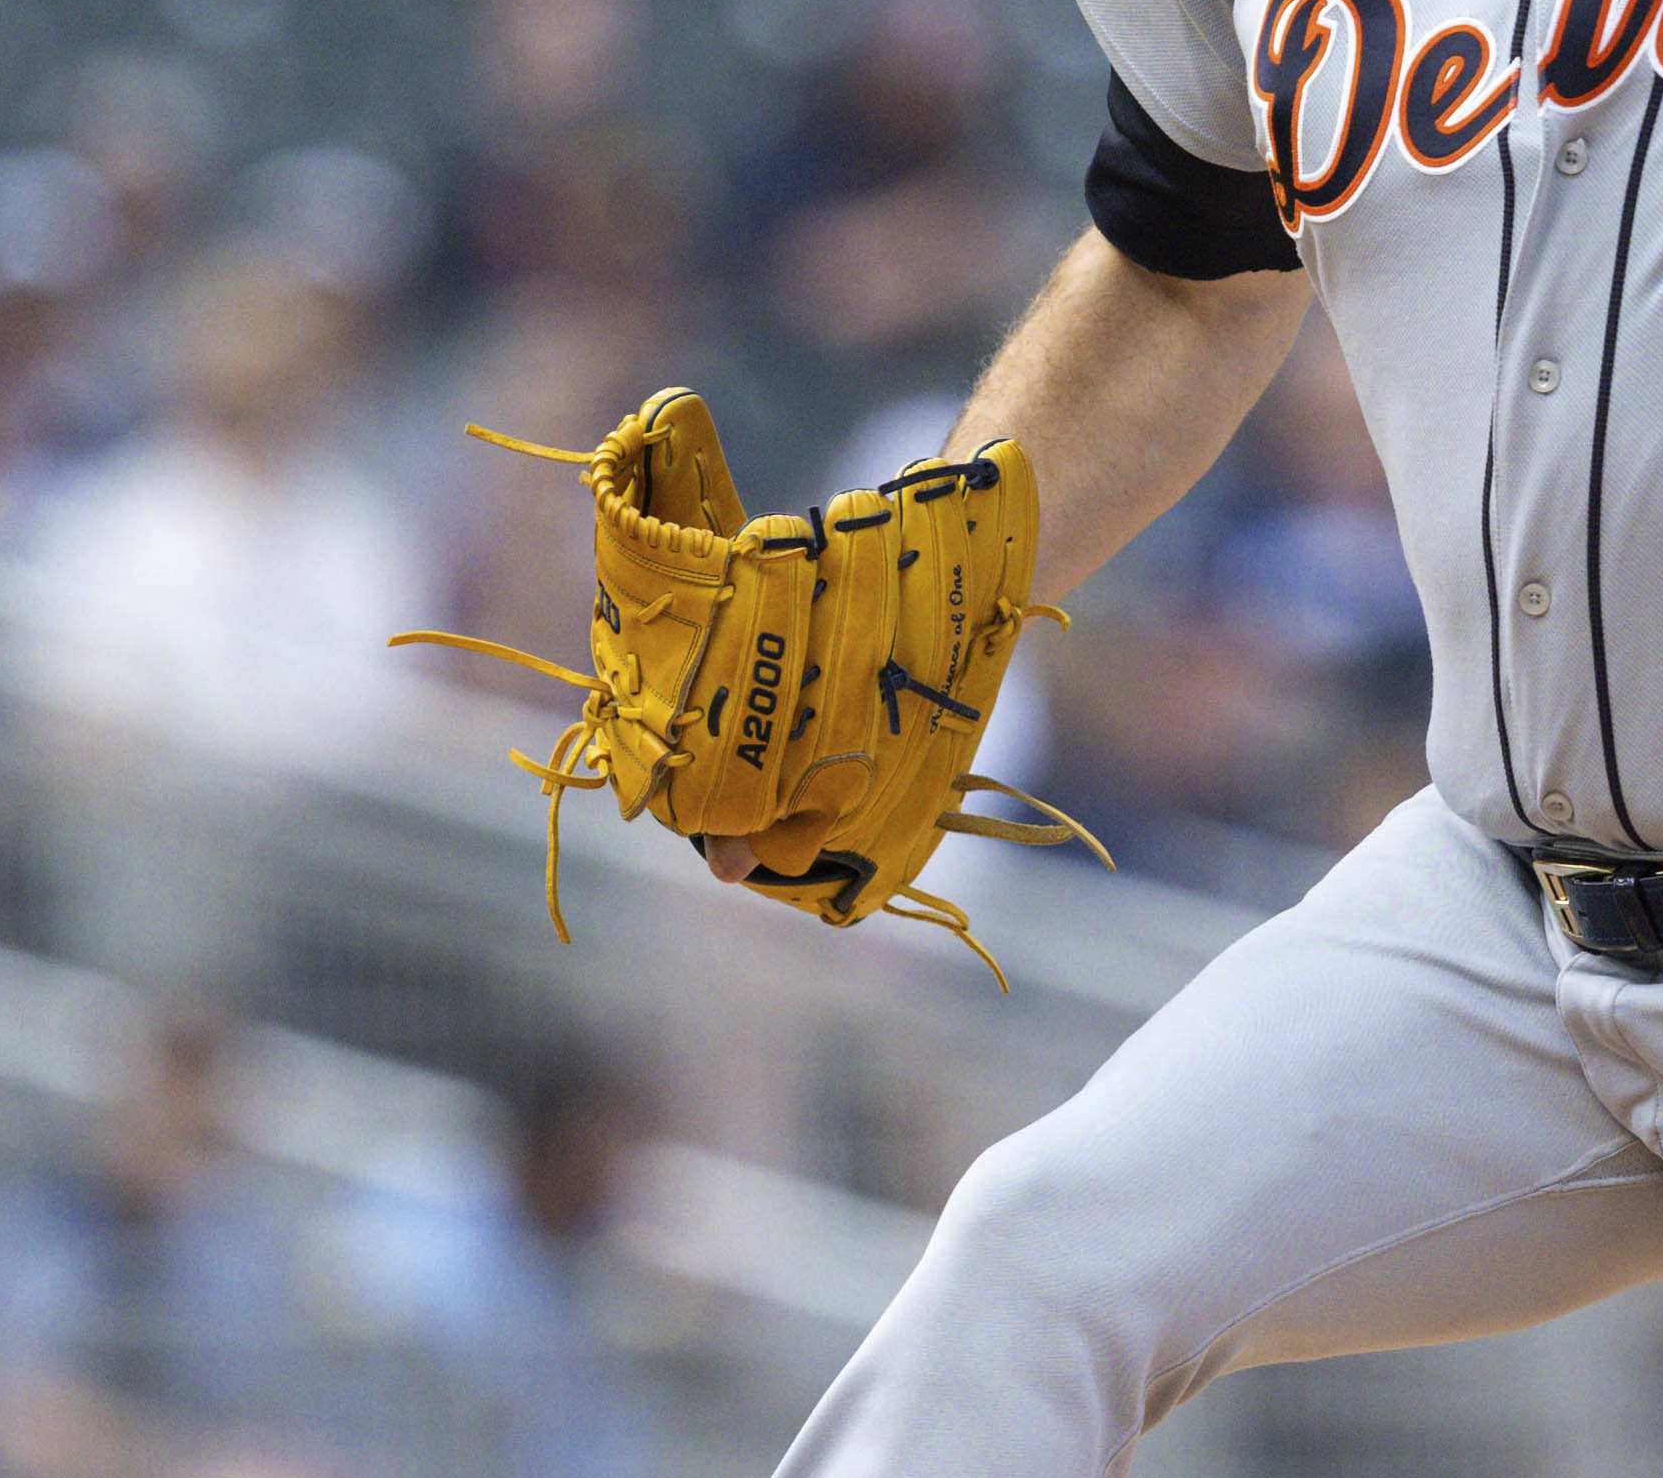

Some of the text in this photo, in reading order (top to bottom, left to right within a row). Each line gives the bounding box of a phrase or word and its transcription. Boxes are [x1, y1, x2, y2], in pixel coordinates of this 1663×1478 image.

[948, 564, 964, 607] One
[949, 610, 966, 636] of
[736, 631, 786, 771] A2000
